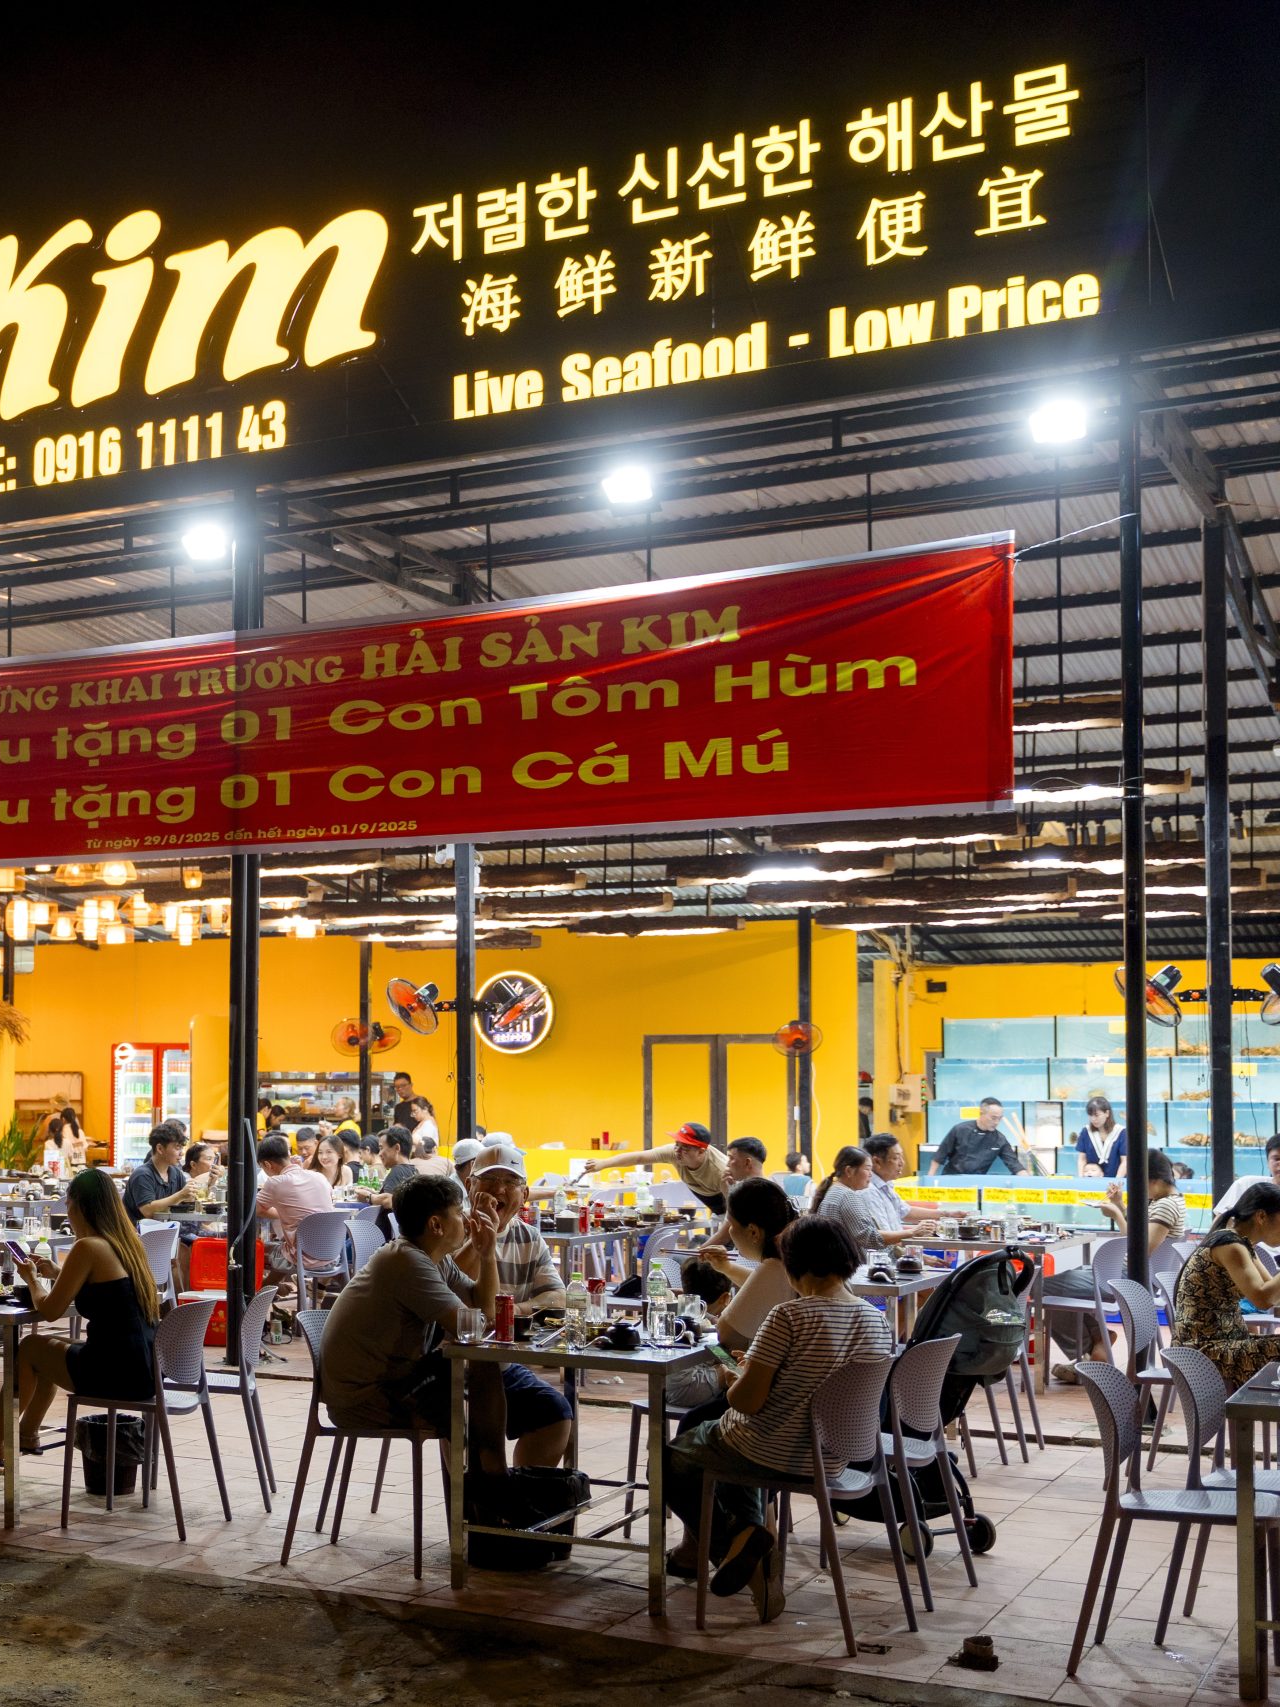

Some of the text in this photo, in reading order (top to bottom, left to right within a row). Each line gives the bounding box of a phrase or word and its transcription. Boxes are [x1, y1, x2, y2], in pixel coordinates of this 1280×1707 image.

[411, 63, 1079, 261] 저렴한 신선한 해산물
[452, 273, 1100, 420] Live Seafood - Low Price
[33, 426, 122, 487] 0916
[136, 411, 223, 467] 1111
[237, 400, 286, 453] 43
[69, 674, 164, 708] KHAI
[174, 655, 345, 698] TRƯƠNG
[360, 628, 464, 680] HẢI
[479, 615, 603, 668] SẢN
[620, 605, 742, 654] KIM
[52, 722, 197, 766] tặng
[220, 707, 291, 745] 01
[329, 699, 483, 735] Con
[508, 675, 680, 720] Tôm
[714, 653, 917, 703] Hùm
[51, 783, 196, 828] tặng
[220, 772, 291, 809] 01
[329, 765, 482, 802] Con
[512, 741, 630, 789] Cá
[664, 728, 790, 780] Mú
[86, 820, 418, 850] Từ ngày 29/8/2025 đến hết ngày 01/9/2025
